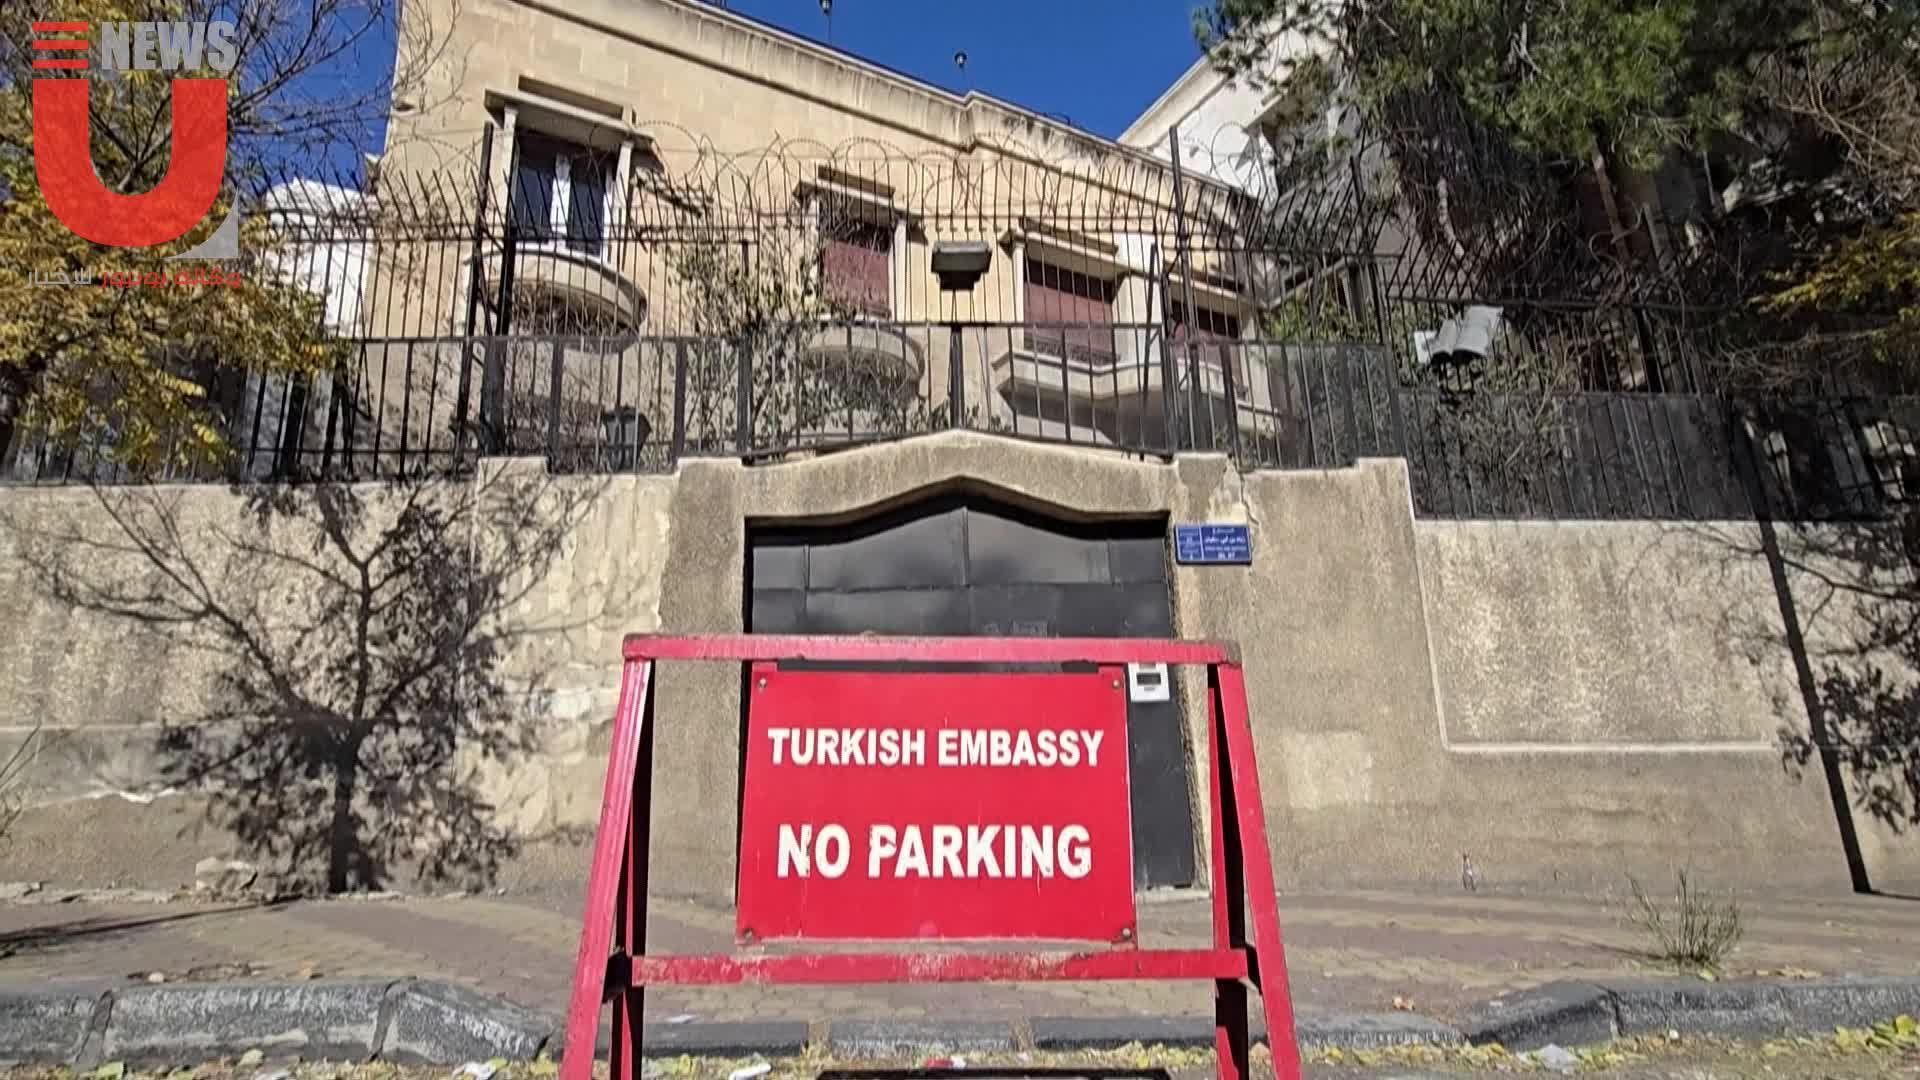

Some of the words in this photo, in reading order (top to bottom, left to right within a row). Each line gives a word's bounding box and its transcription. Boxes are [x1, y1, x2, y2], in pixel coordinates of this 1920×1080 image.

[767, 727, 926, 766] TURKISH
[938, 728, 1104, 766] EMBASSY
[777, 823, 851, 878] NO
[868, 824, 1092, 879] PARKING
